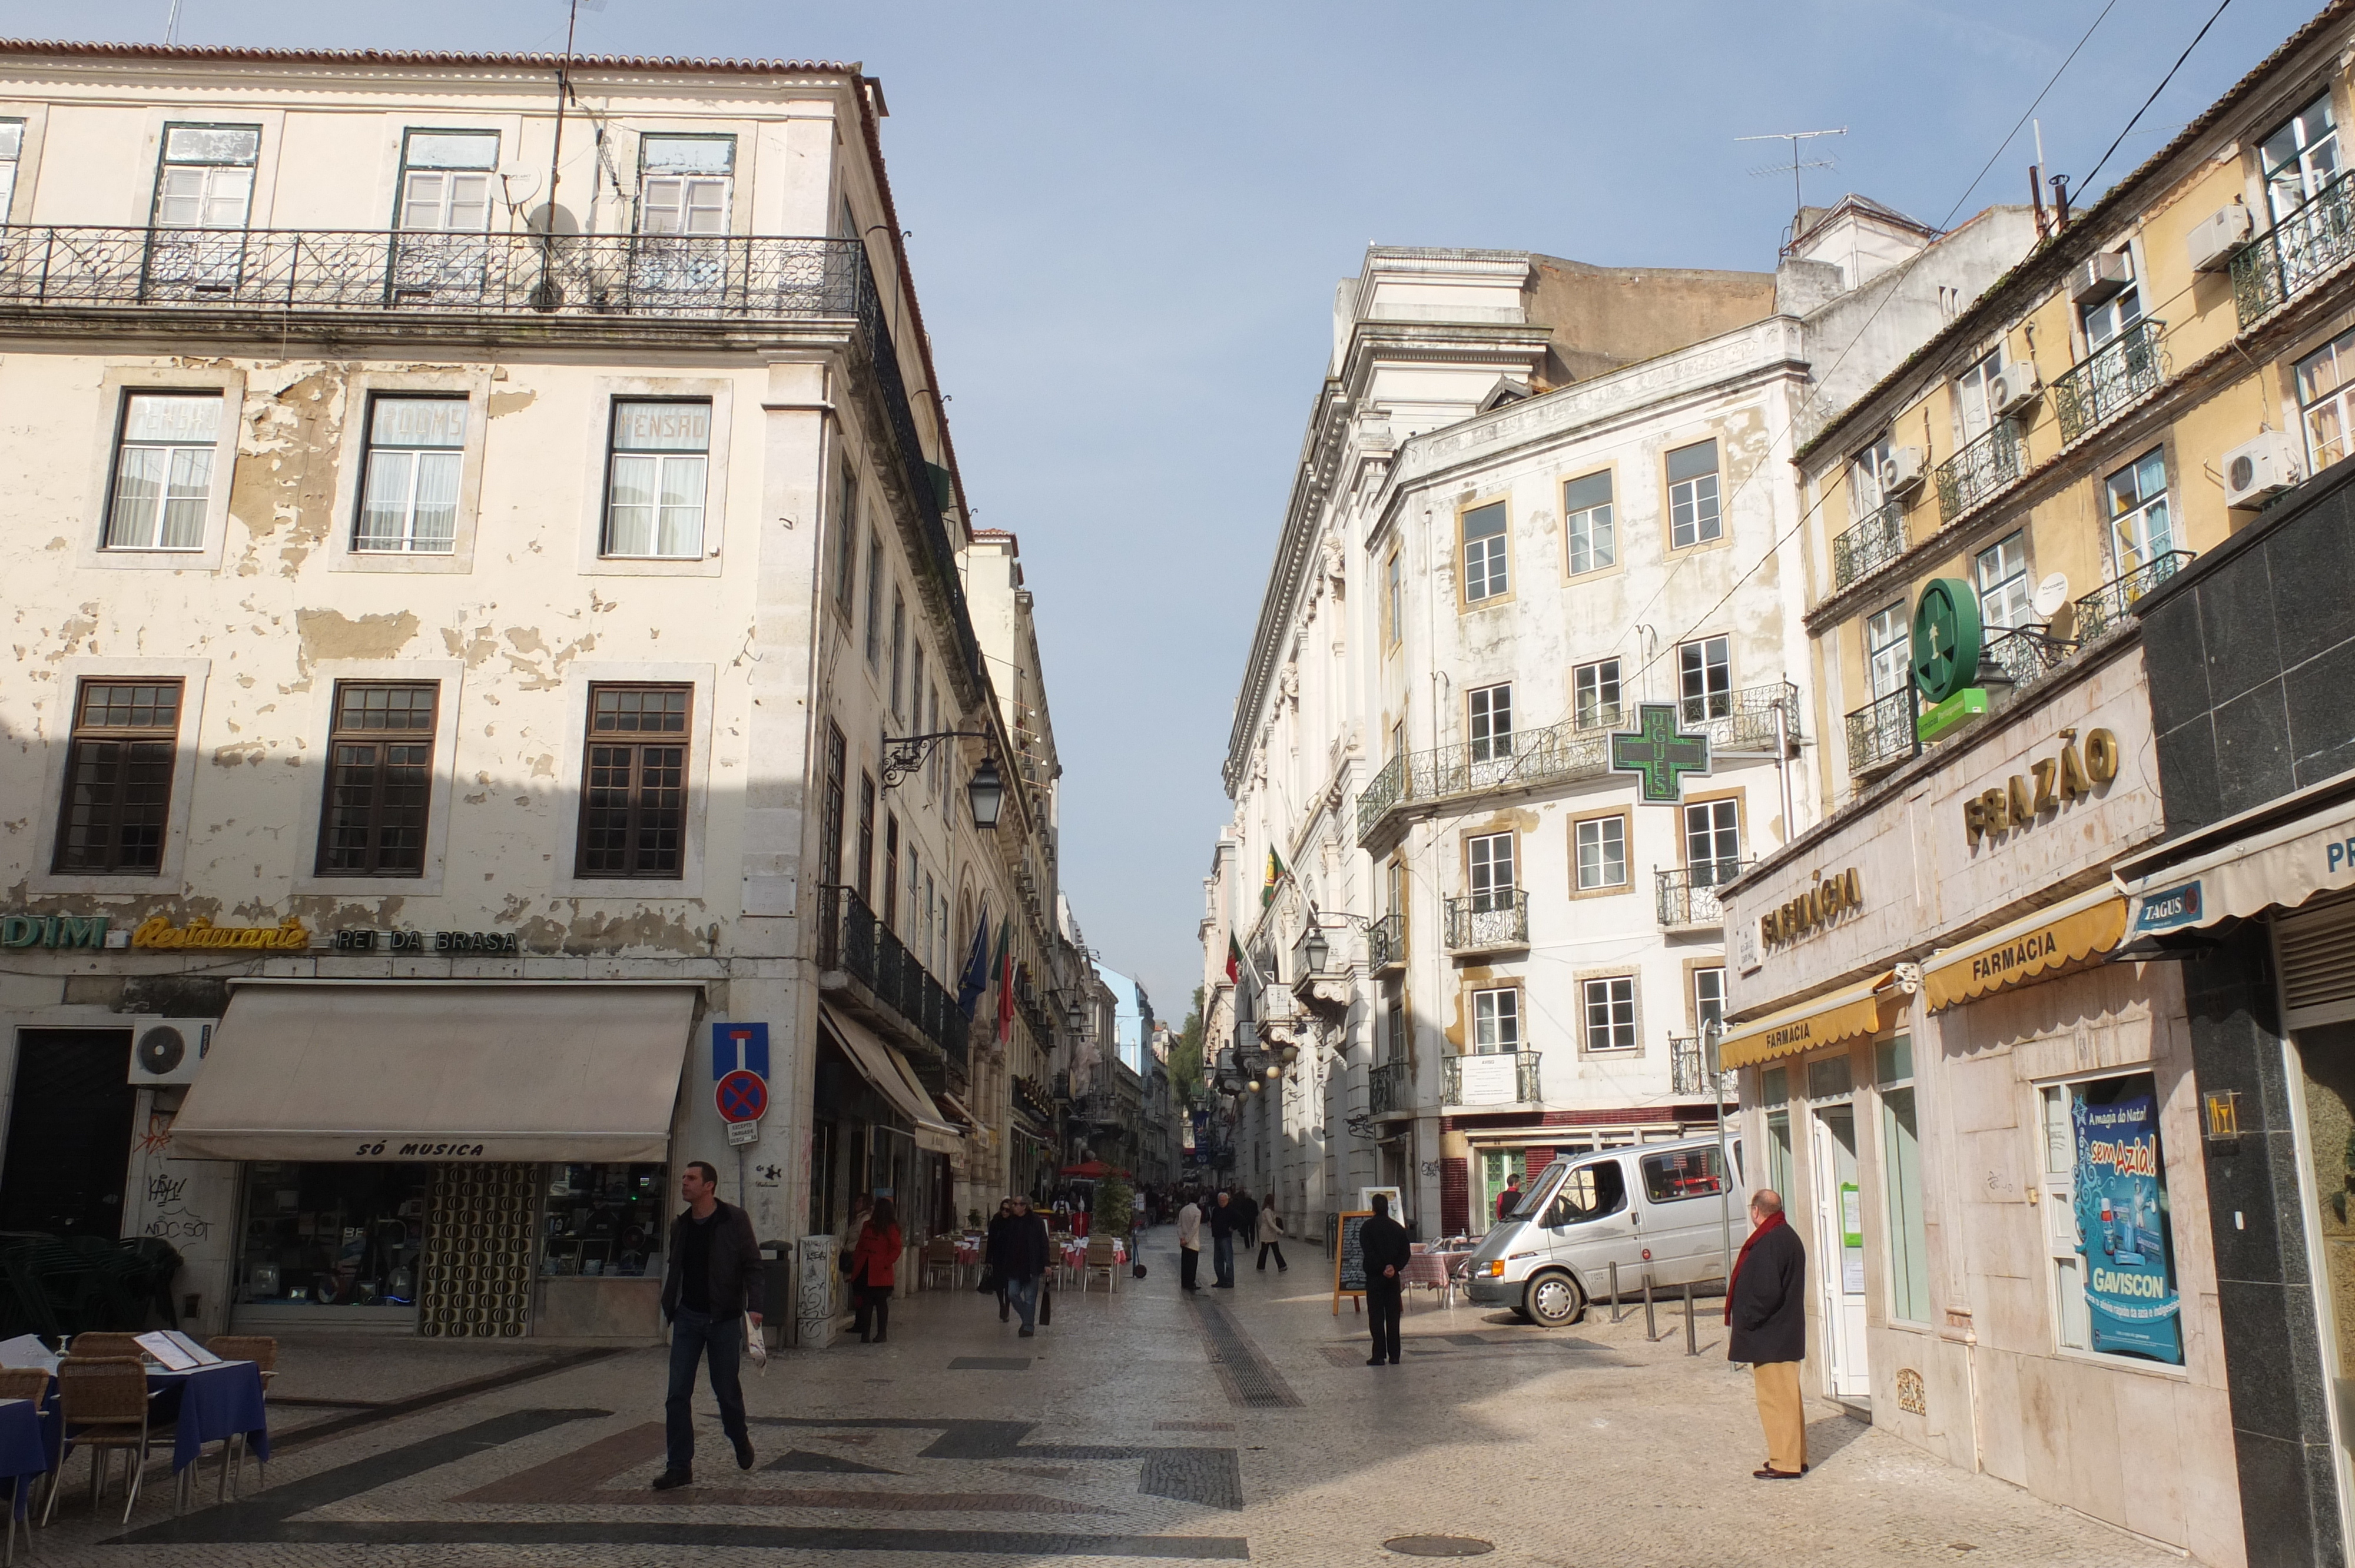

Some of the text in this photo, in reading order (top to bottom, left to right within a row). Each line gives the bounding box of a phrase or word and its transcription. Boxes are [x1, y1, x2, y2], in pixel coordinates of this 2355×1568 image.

[383, 408, 463, 436] ROOMS
[1963, 727, 2118, 846] FRAZÃO
[1761, 868, 1862, 949] FARMÁCIA
[2144, 897, 2181, 921] TAGUS
[132, 915, 310, 949] Restaurante
[336, 930, 519, 954] REI DA BRASA
[1973, 931, 2057, 981] FARMÁCIA
[2089, 1113, 2095, 1125] A
[2118, 1108, 2125, 1123] do
[2127, 1105, 2147, 1122] Natal
[356, 1140, 484, 1156] SÓ MUSICA
[2091, 1134, 2155, 1177] sem Azia!
[2093, 1267, 2164, 1298] GAVISCON
